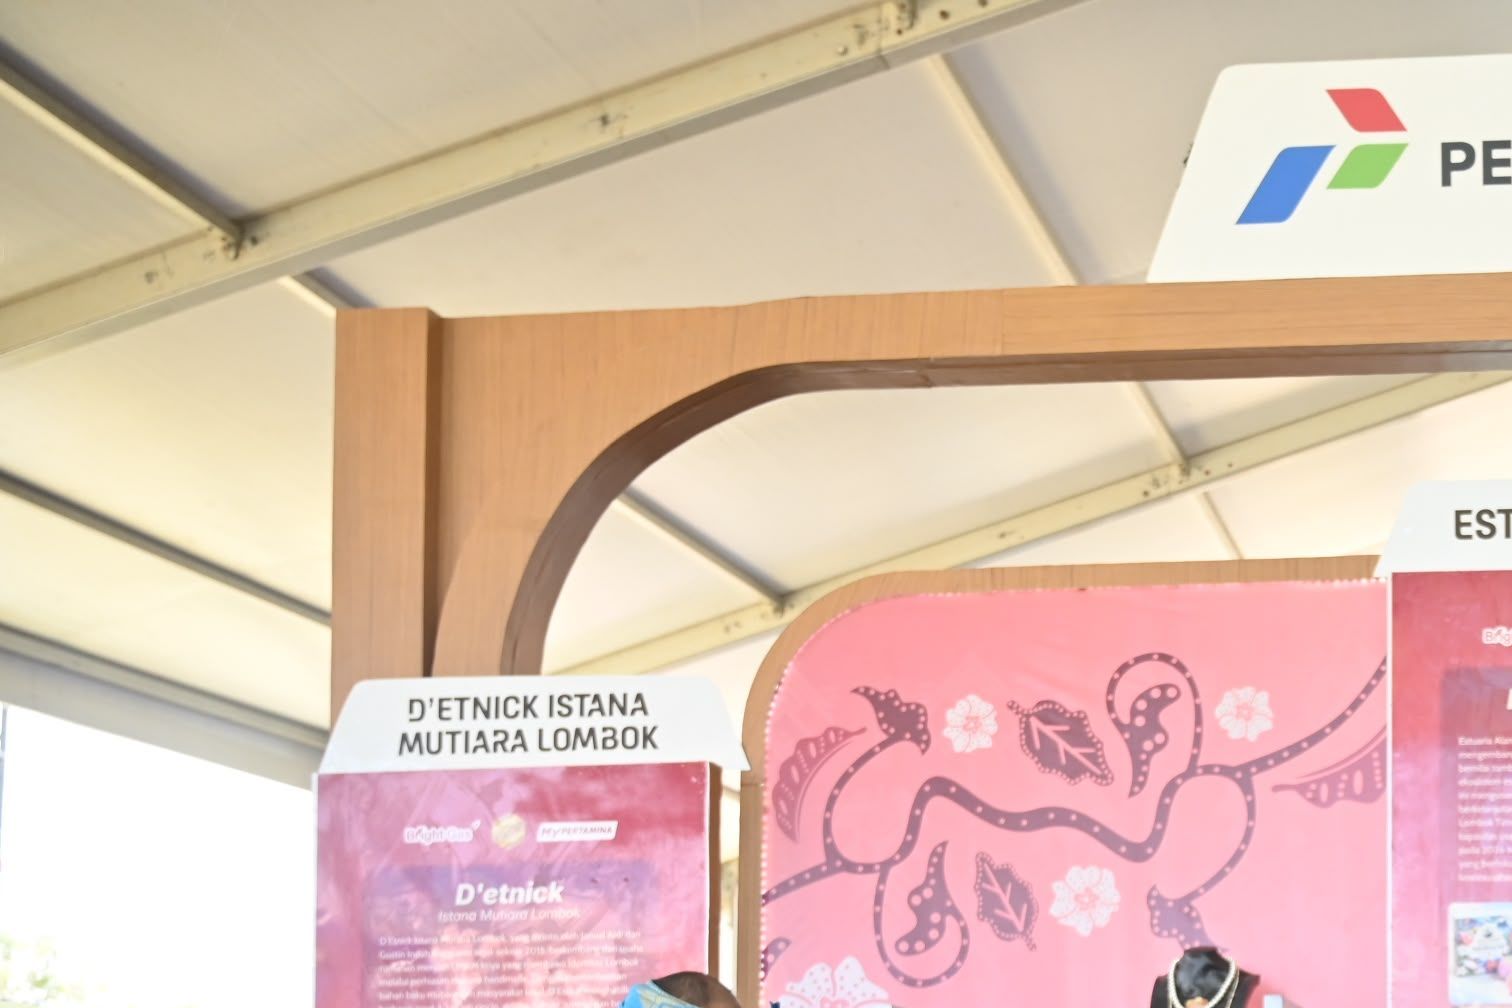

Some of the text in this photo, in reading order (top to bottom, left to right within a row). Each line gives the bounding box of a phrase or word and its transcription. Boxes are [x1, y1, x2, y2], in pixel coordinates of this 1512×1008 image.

[408, 692, 649, 722] D'ETNICK ISTANA
[398, 725, 660, 756] MUTIARA LOMBOK
[454, 880, 565, 906] D'etnick
[438, 908, 582, 923] Istana Mutiara Lombok
